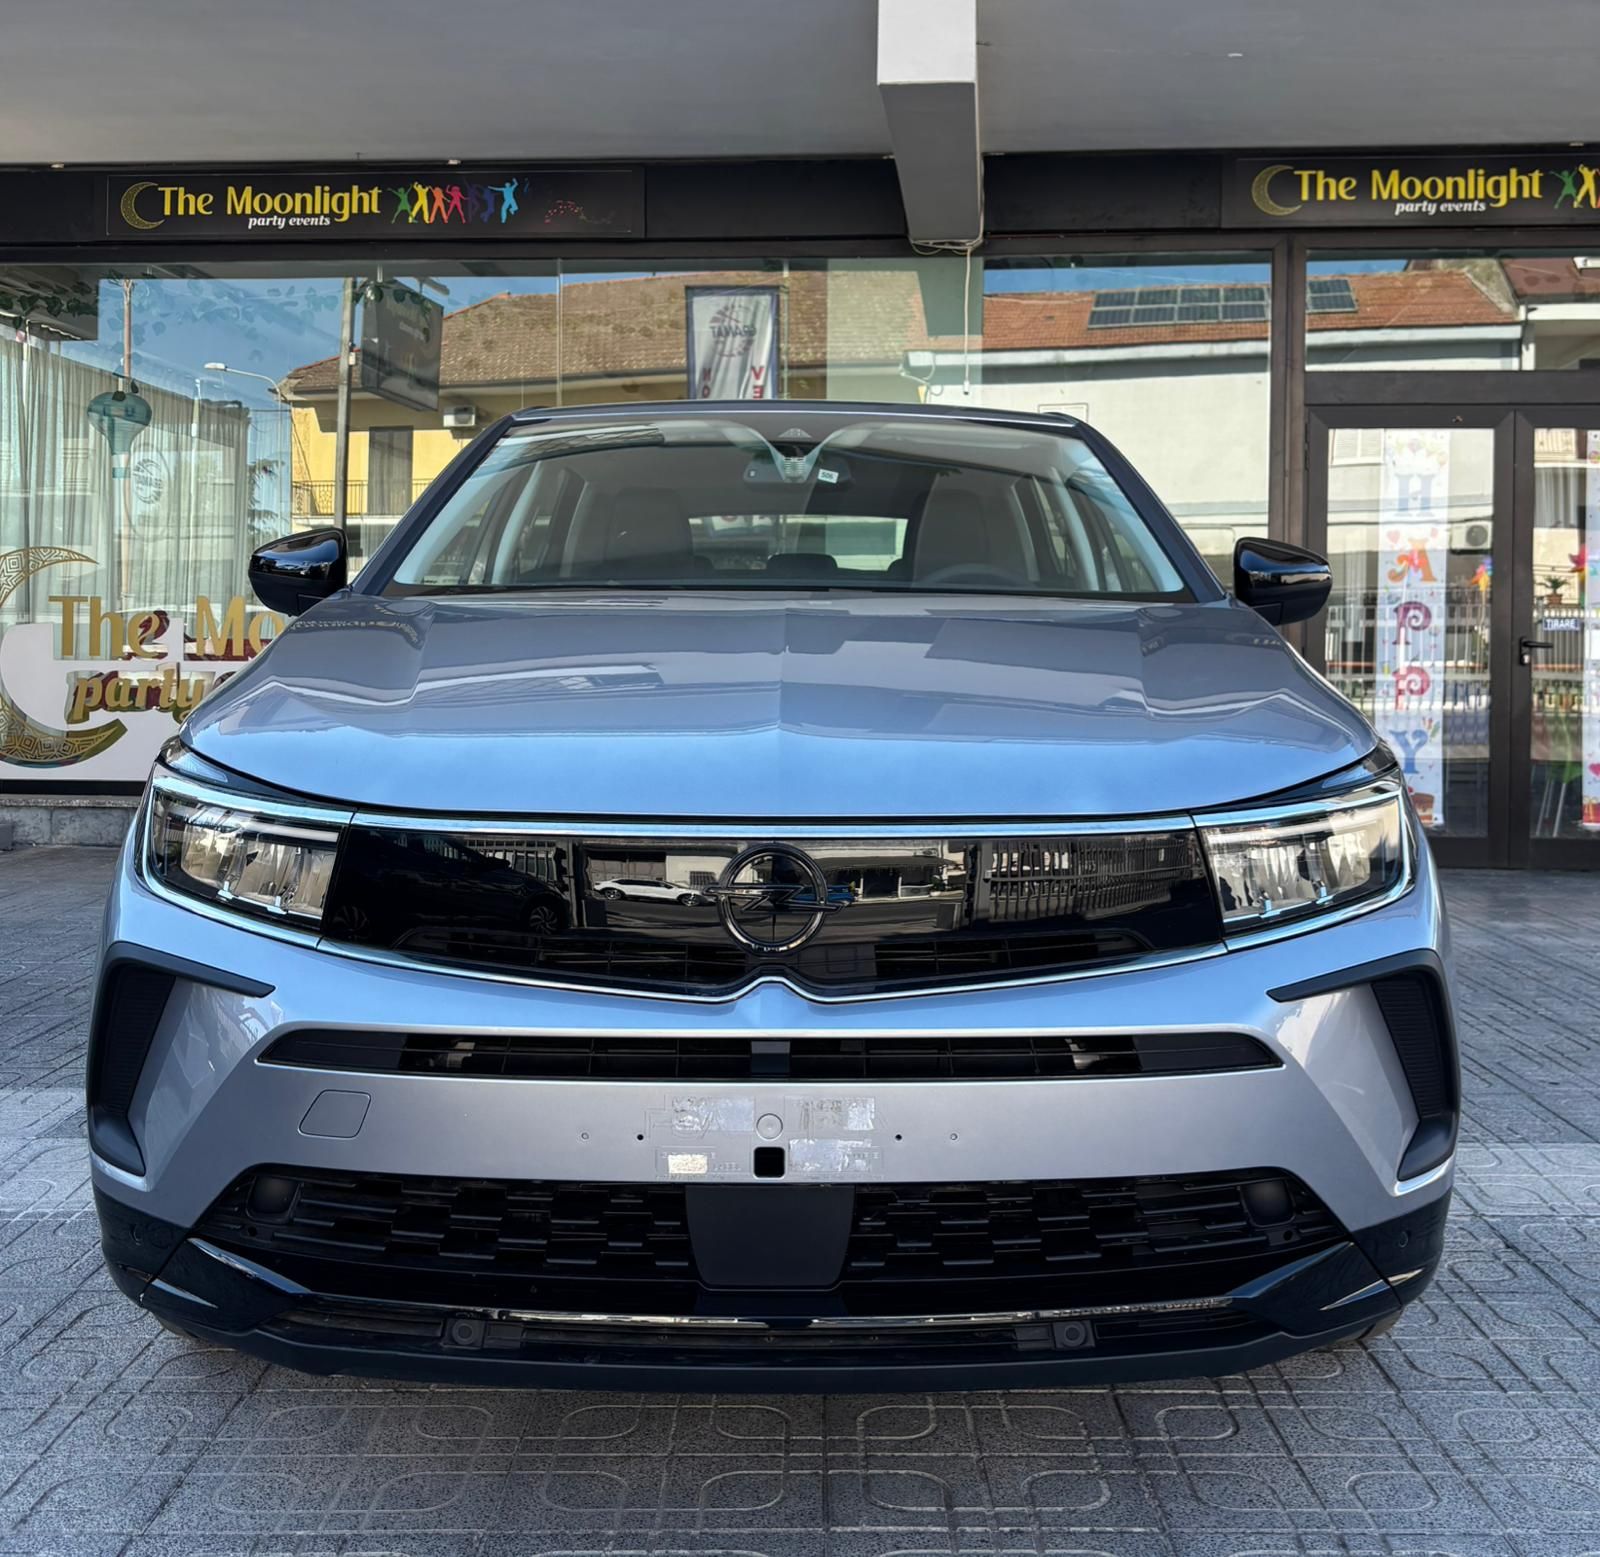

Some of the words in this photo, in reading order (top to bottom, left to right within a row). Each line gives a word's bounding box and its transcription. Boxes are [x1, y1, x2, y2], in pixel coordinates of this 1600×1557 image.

[158, 185, 214, 216] The
[226, 184, 382, 222] Moonlight
[1294, 169, 1357, 201] The
[1371, 167, 1544, 208] Moonlight
[248, 214, 286, 230] party
[288, 214, 331, 227] events
[1395, 200, 1437, 216] party
[1440, 200, 1486, 213] events
[48, 595, 160, 659] The
[1387, 473, 1437, 774] HAPPY
[1545, 618, 1577, 629] TIRARE
[73, 664, 206, 720] party
